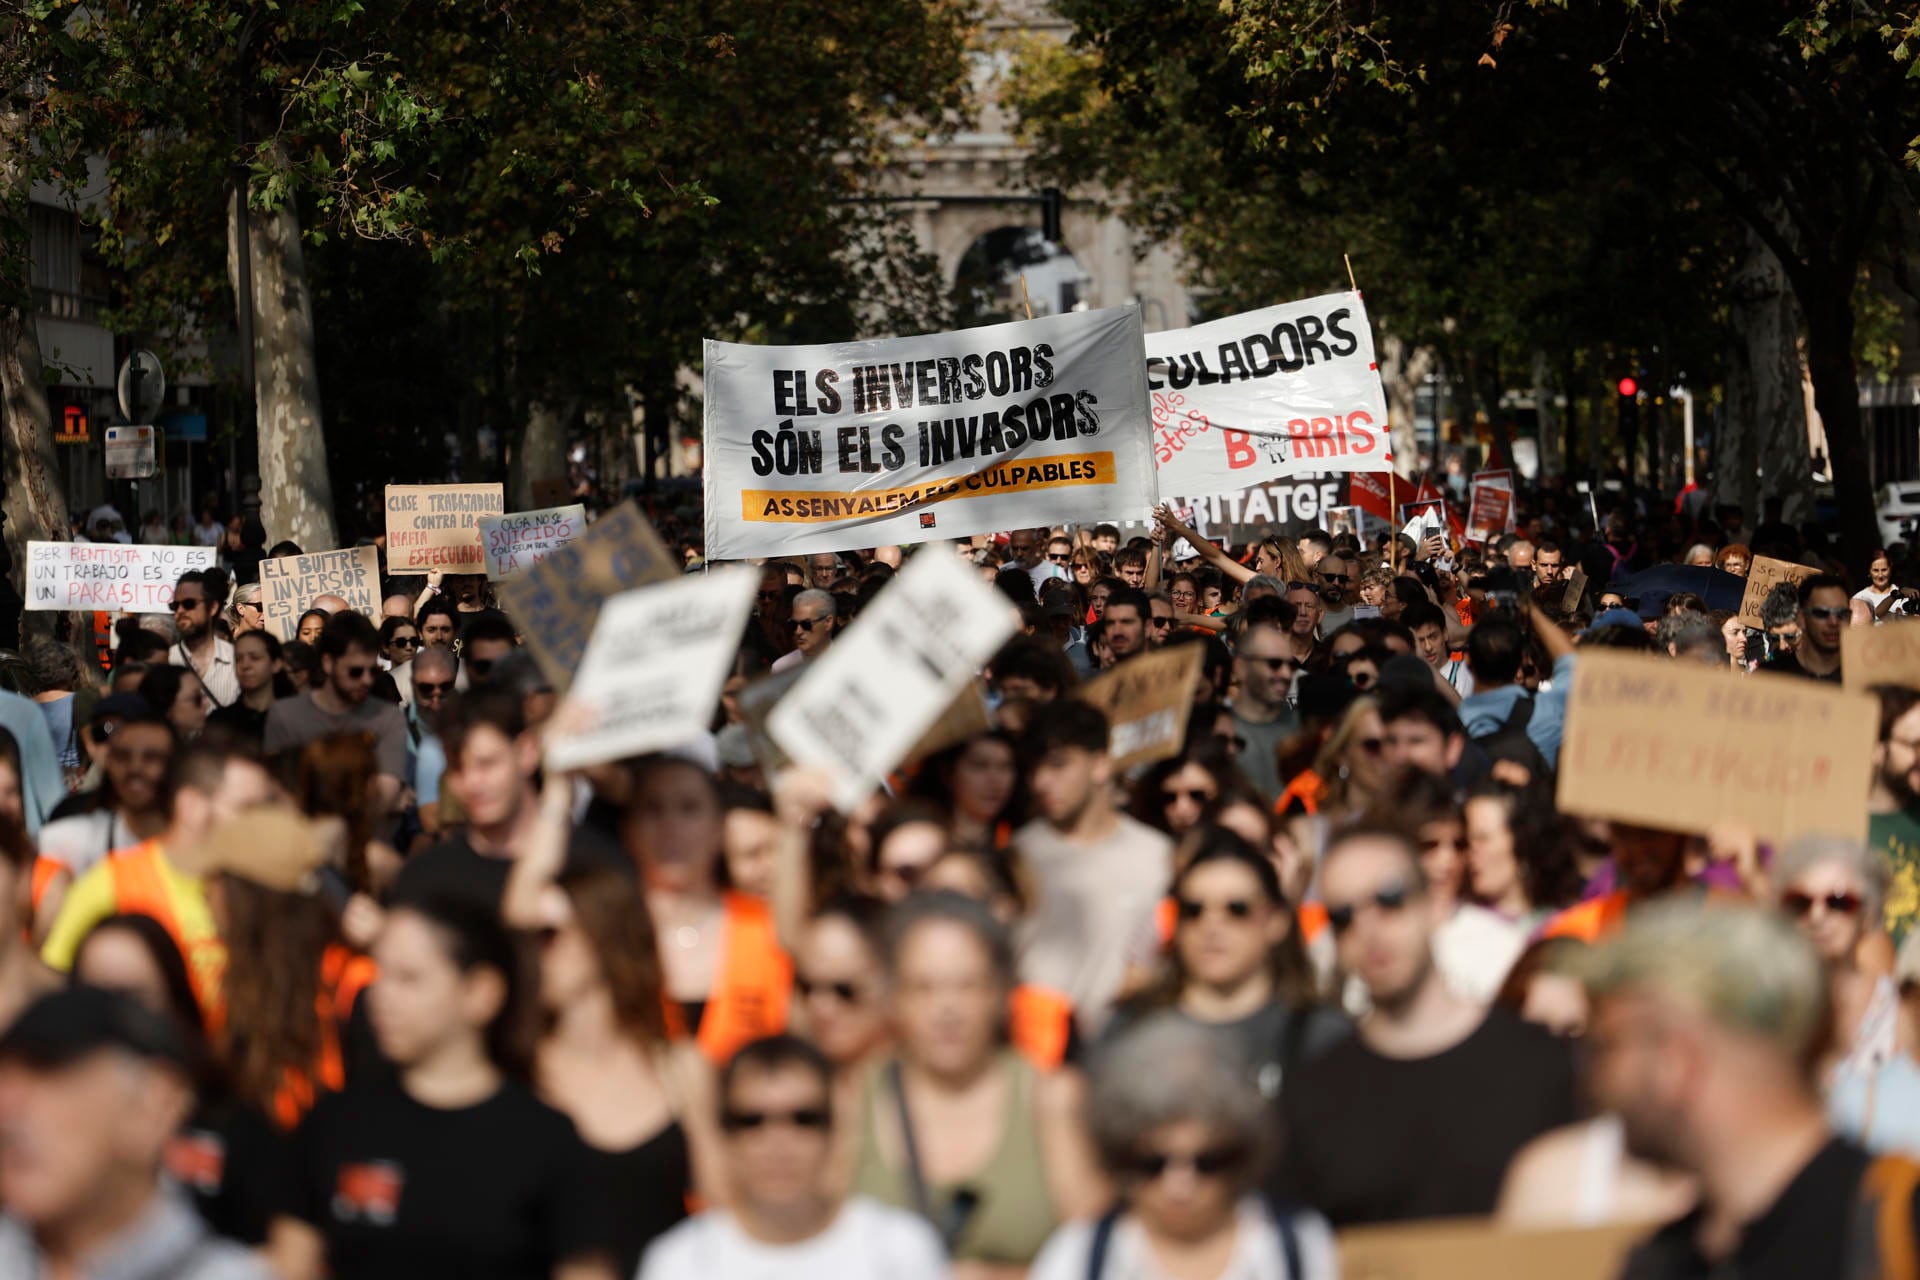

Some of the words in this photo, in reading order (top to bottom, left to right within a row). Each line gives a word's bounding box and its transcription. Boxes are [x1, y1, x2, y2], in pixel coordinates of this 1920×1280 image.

[773, 368, 842, 417] ELS
[852, 343, 1055, 415] INVERSORS
[752, 418, 823, 476] SÓN
[836, 423, 906, 473] ELS
[918, 389, 1101, 468] INVASORS
[763, 490, 920, 517] ASSENYALEM
[965, 460, 1097, 490] CULPABLES
[387, 494, 418, 512] CLASE
[428, 493, 503, 512] TRABAJADORA
[413, 513, 457, 530] CONTRA
[461, 513, 474, 529] LA
[501, 518, 531, 532] OLGA
[536, 513, 550, 526] NO
[390, 530, 428, 547] MAFIA
[489, 518, 573, 549] SUICIDÓ
[33, 546, 61, 561] SER
[70, 546, 142, 563] RENTISTA
[151, 551, 176, 564] NO
[186, 551, 207, 565] ES
[262, 559, 290, 579] EL
[296, 550, 363, 575] BUITRE
[498, 554, 520, 576] LA
[34, 565, 56, 580] UN
[64, 564, 129, 580] TRABAJO
[143, 565, 162, 580] ES
[1757, 564, 1777, 577] se
[36, 586, 56, 601] UN
[67, 582, 175, 605] PARASITO
[272, 568, 367, 601] INVERSOR
[267, 601, 292, 618] ES
